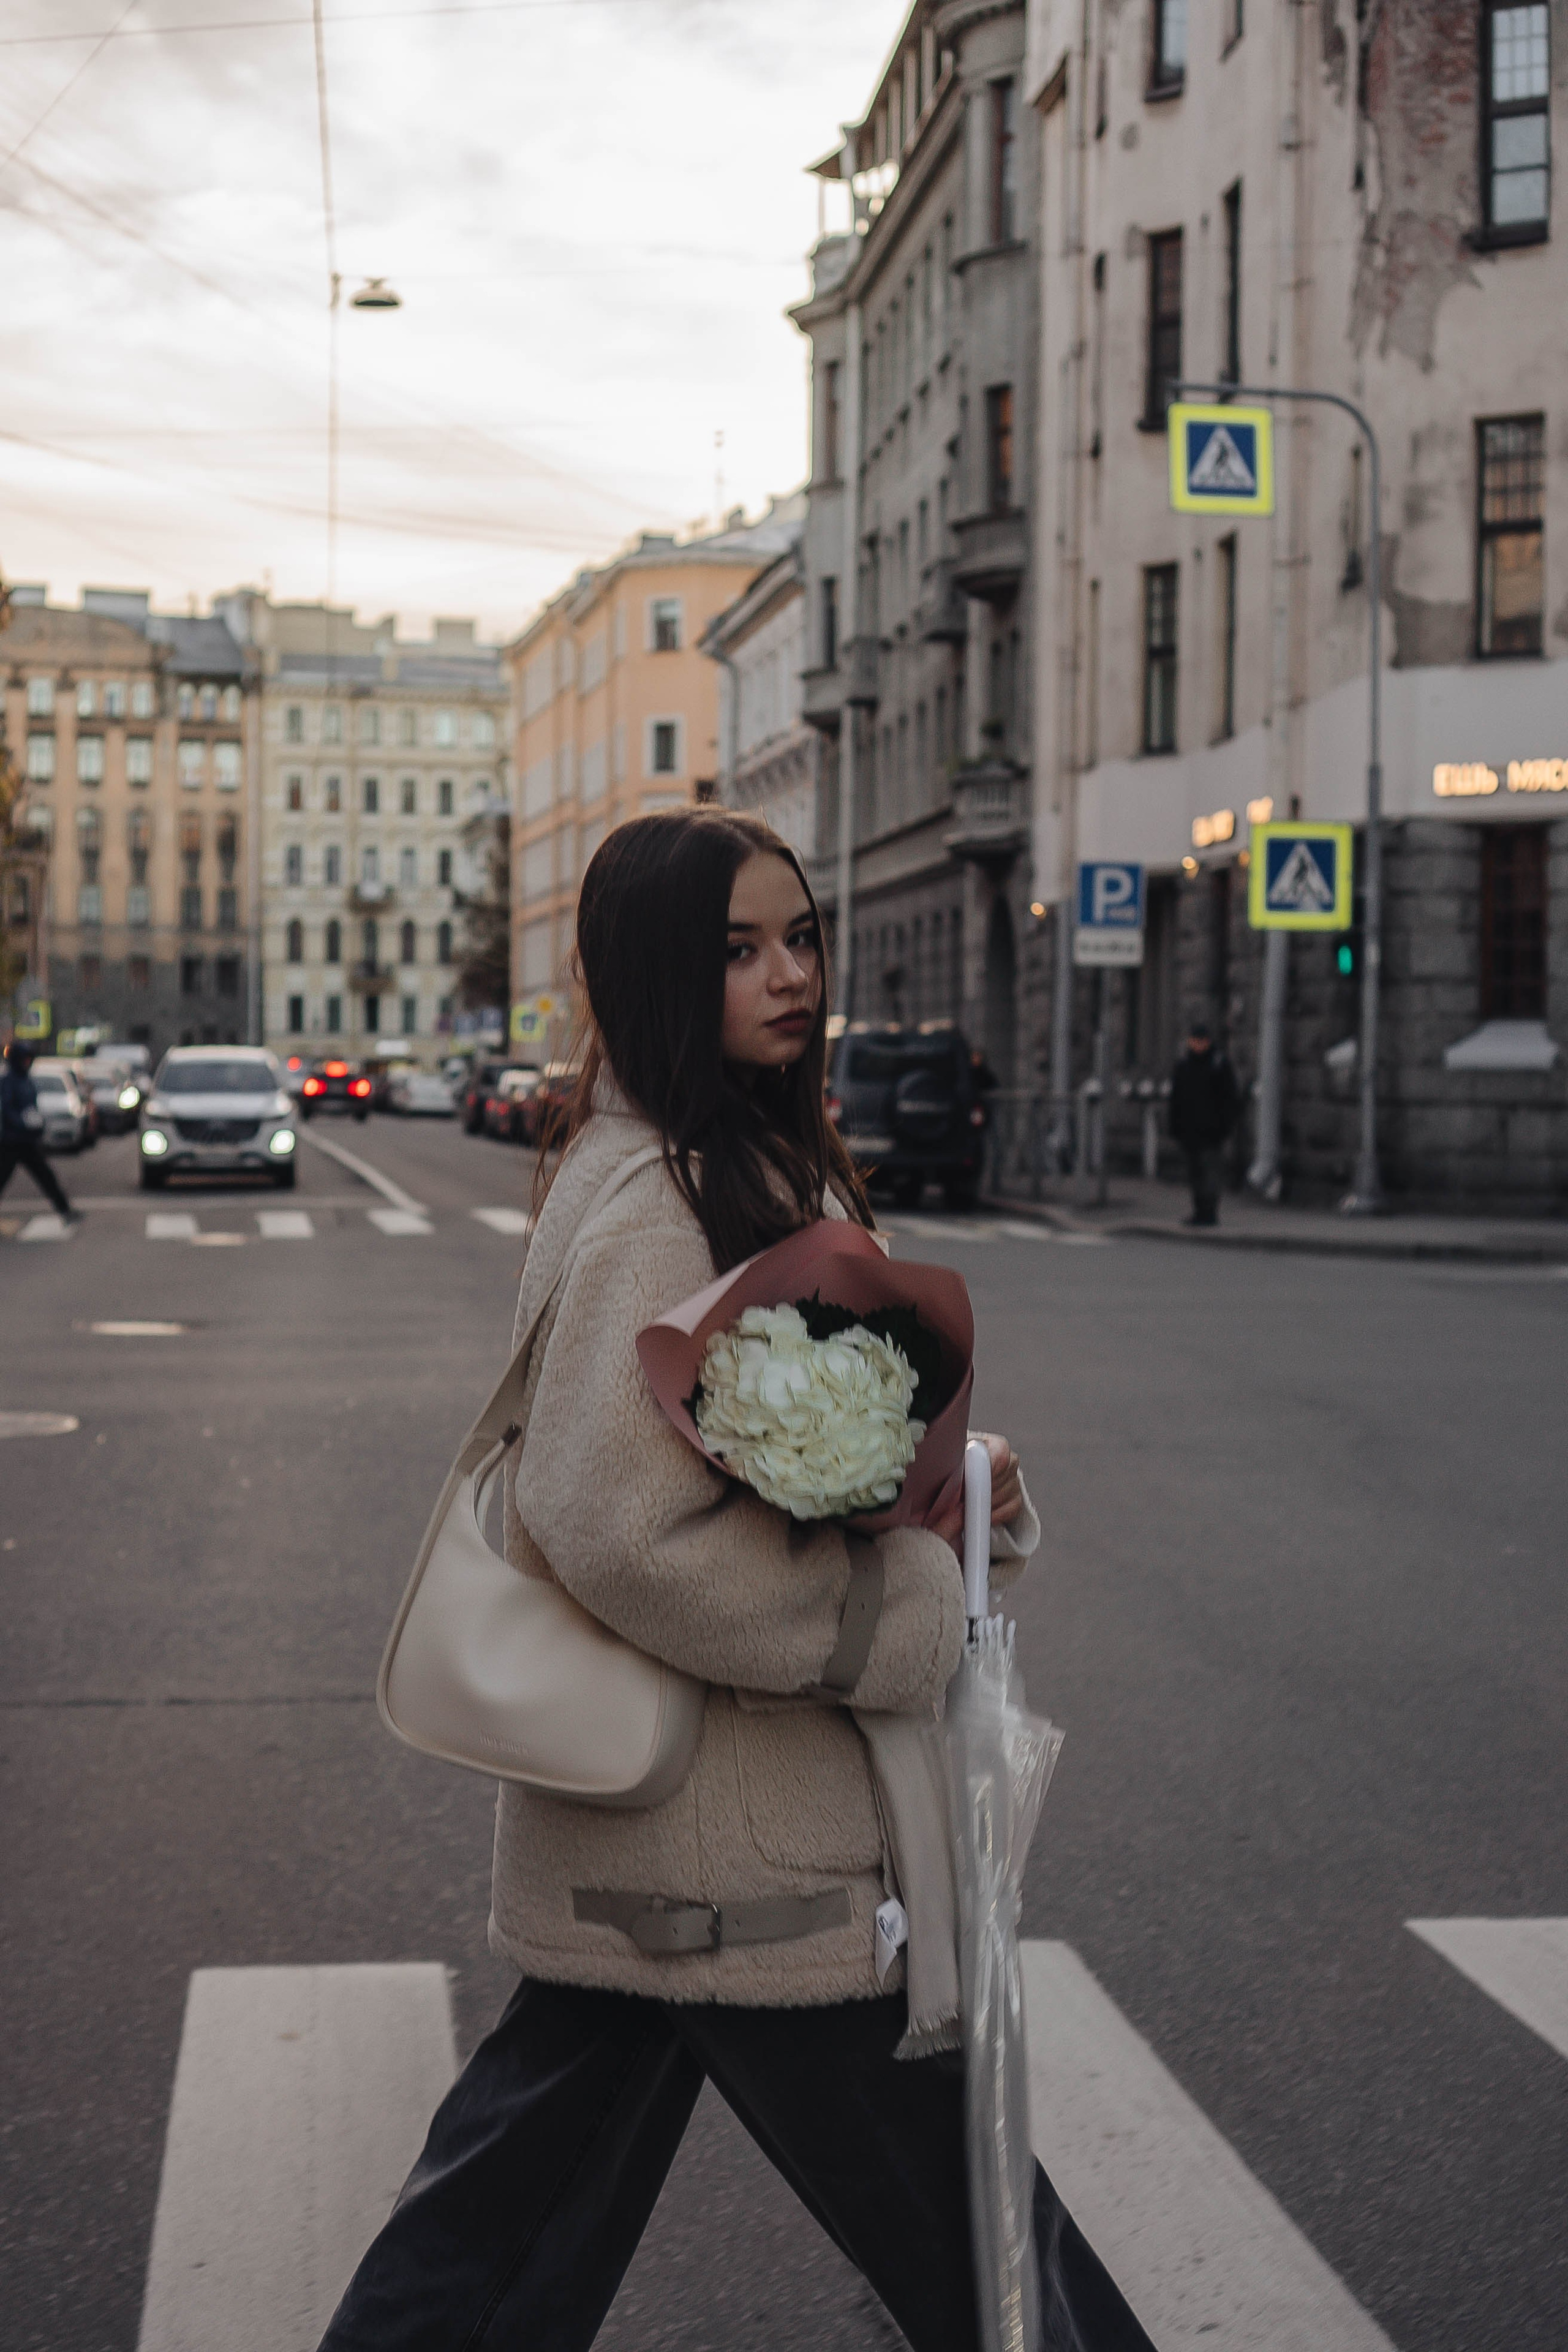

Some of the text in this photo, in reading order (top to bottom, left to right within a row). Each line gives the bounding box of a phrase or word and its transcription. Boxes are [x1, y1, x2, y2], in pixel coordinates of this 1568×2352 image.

[1433, 758, 1568, 796] ЕШЬ МЯС
[1094, 867, 1133, 921] P
